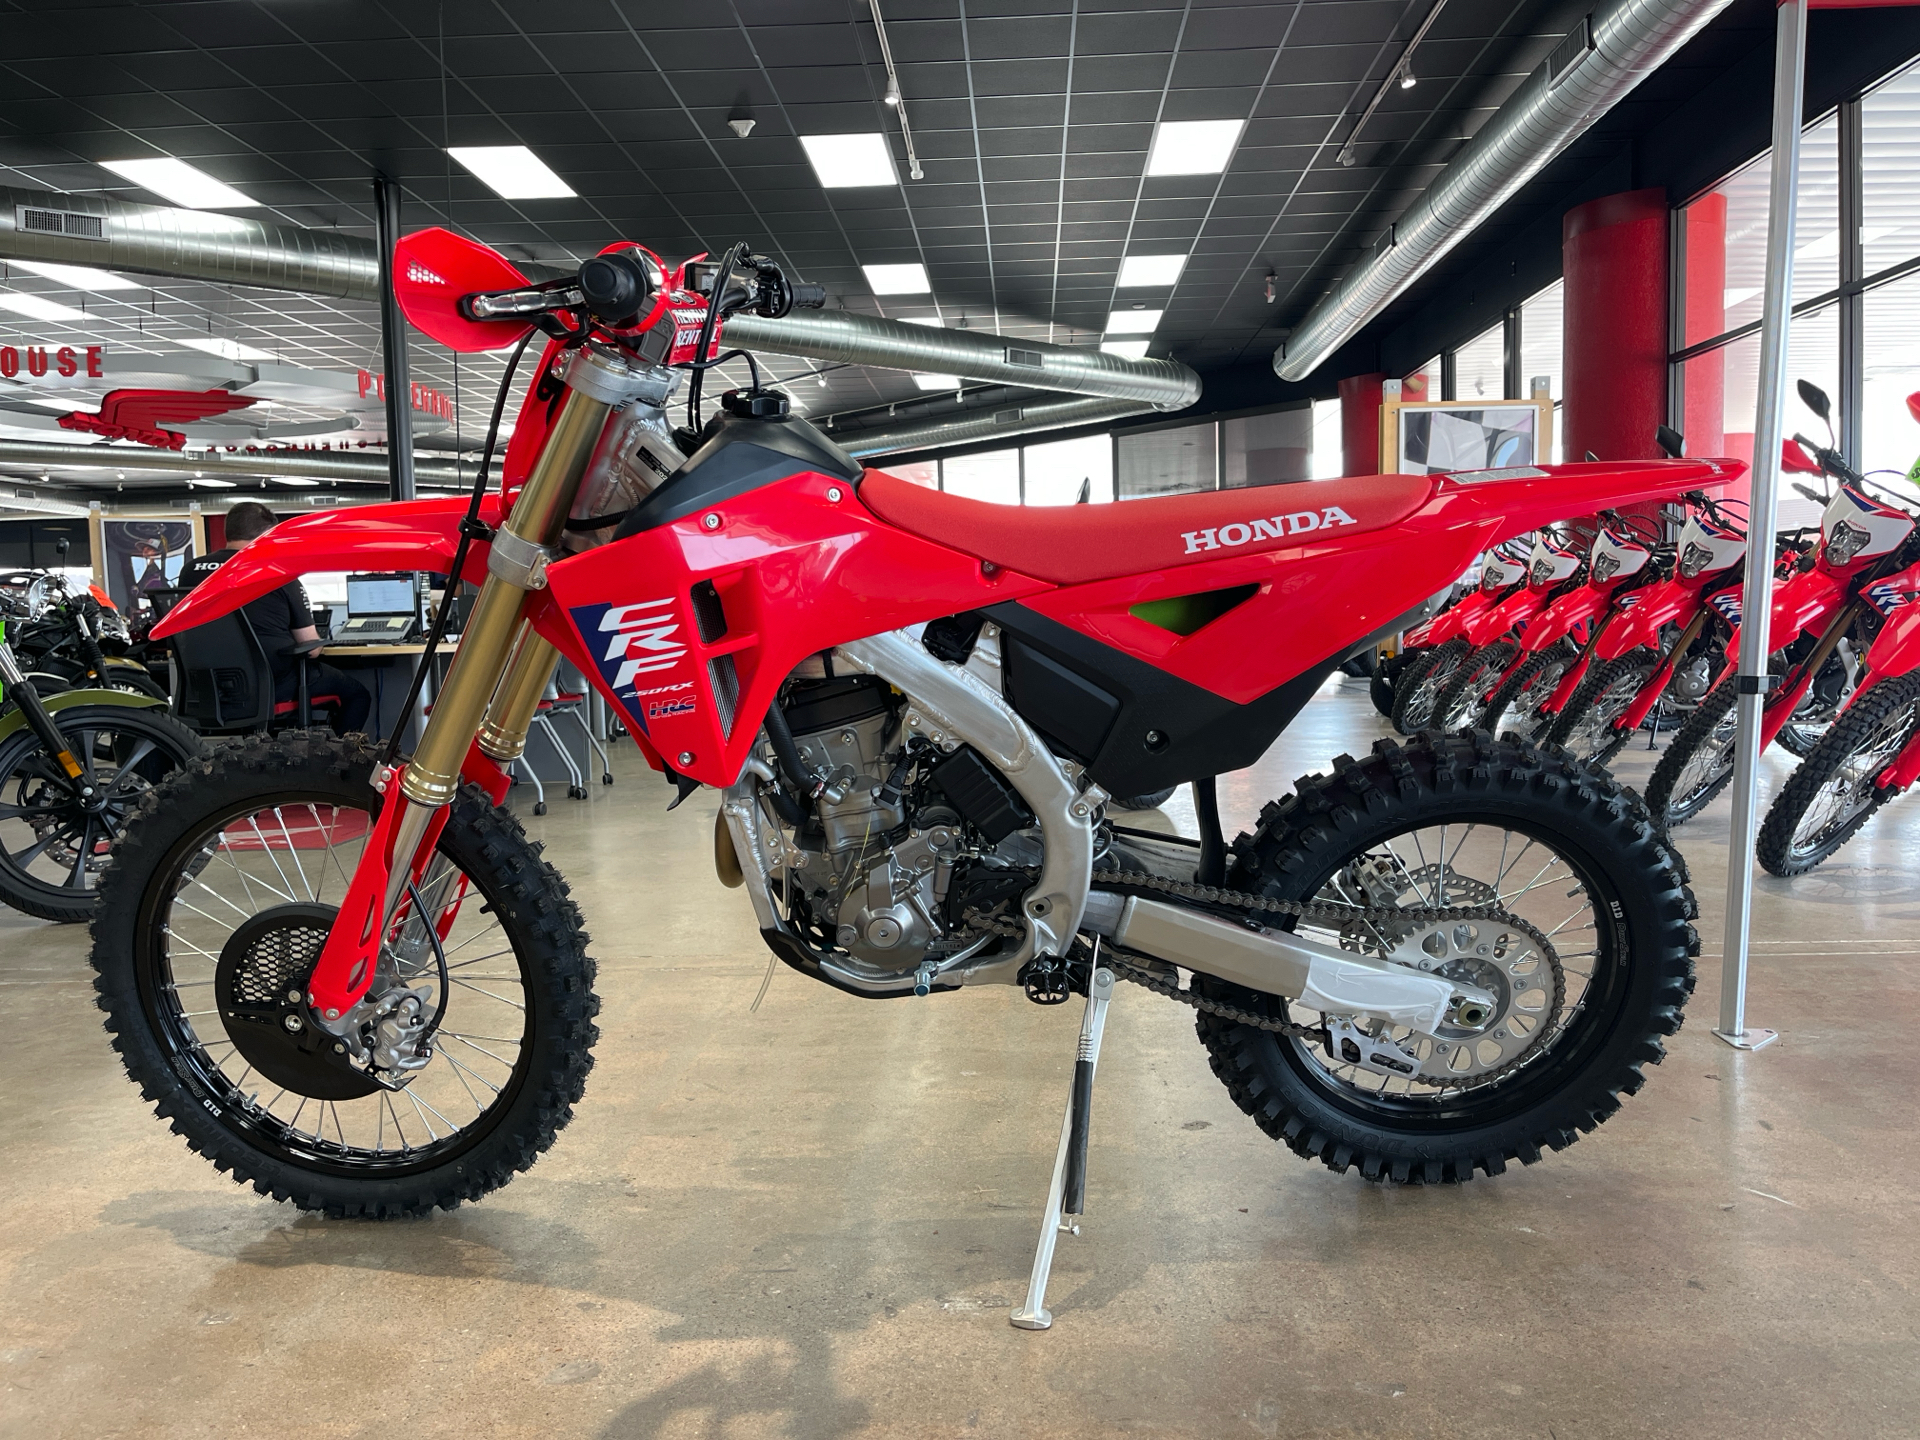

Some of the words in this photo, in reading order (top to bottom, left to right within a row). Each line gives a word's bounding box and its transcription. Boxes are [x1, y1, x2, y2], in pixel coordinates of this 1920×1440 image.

[0, 346, 103, 377] OUSE
[1180, 506, 1357, 555] HONDA
[598, 597, 689, 690] CRF
[621, 681, 695, 699] 250RX
[649, 694, 697, 717] HRC
